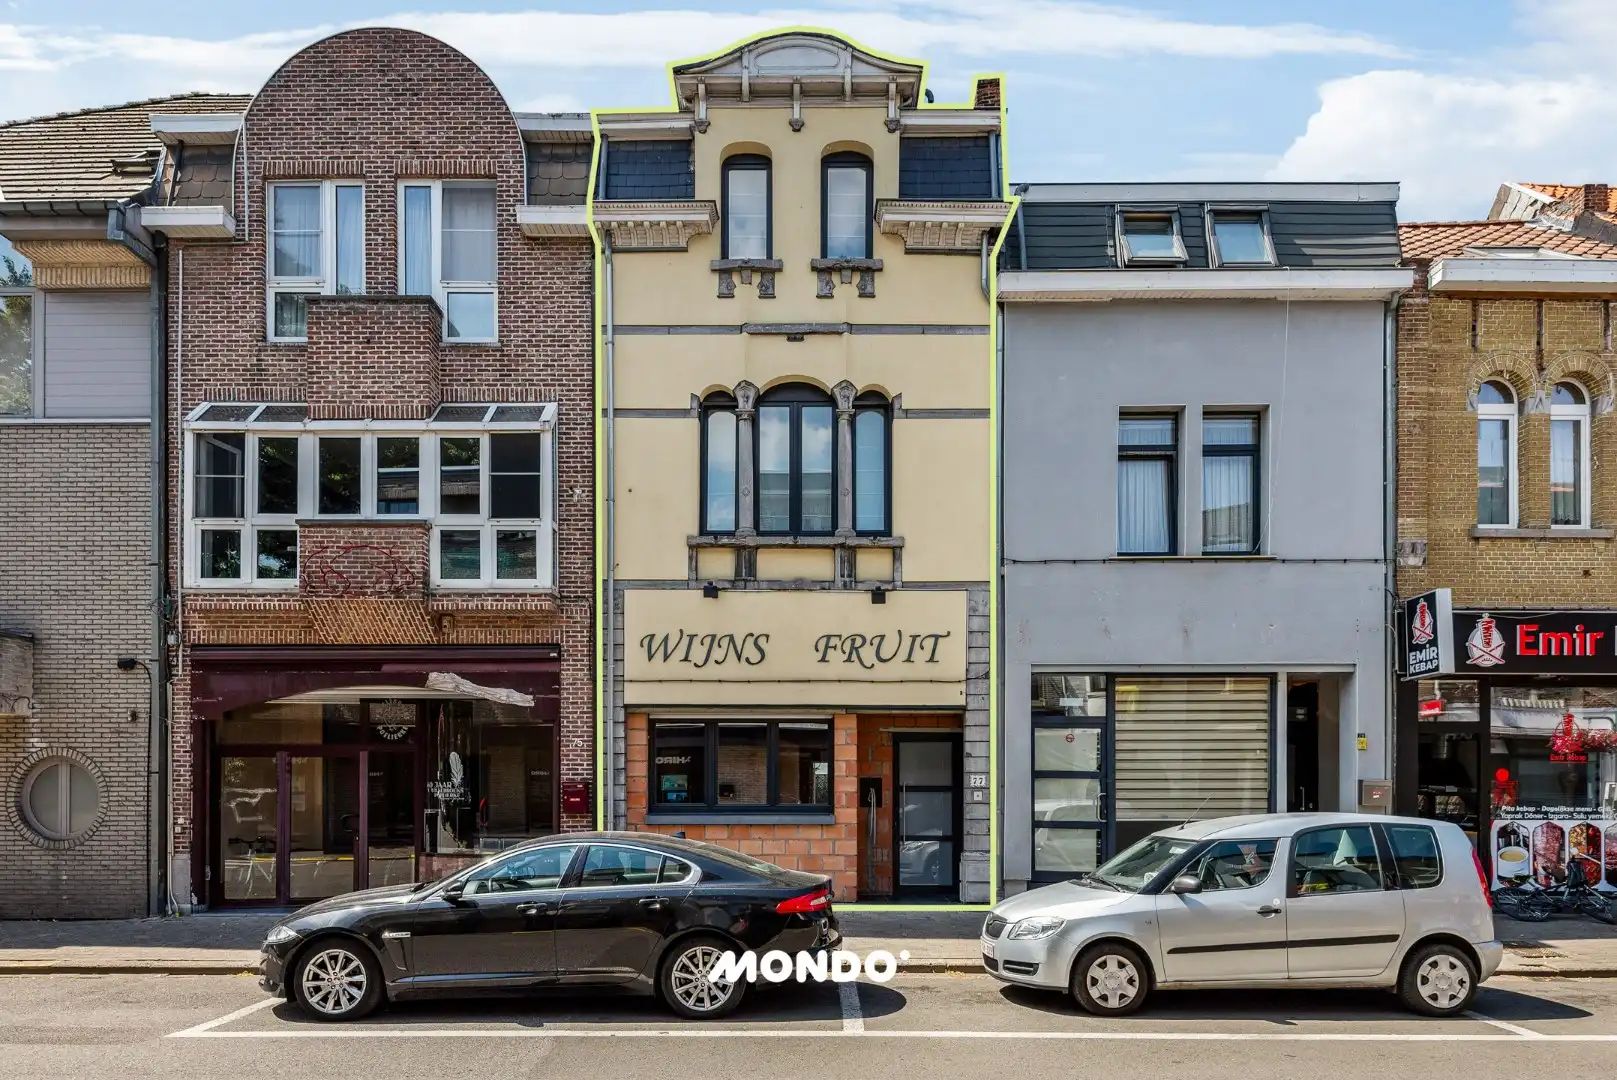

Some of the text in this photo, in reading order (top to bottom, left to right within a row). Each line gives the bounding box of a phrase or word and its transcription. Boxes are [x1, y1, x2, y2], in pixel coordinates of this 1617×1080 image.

[639, 629, 951, 669] WIJNS FRUIT
[1516, 624, 1604, 656] Emir
[1409, 660, 1439, 674] KEBAP
[572, 738, 583, 747] 75
